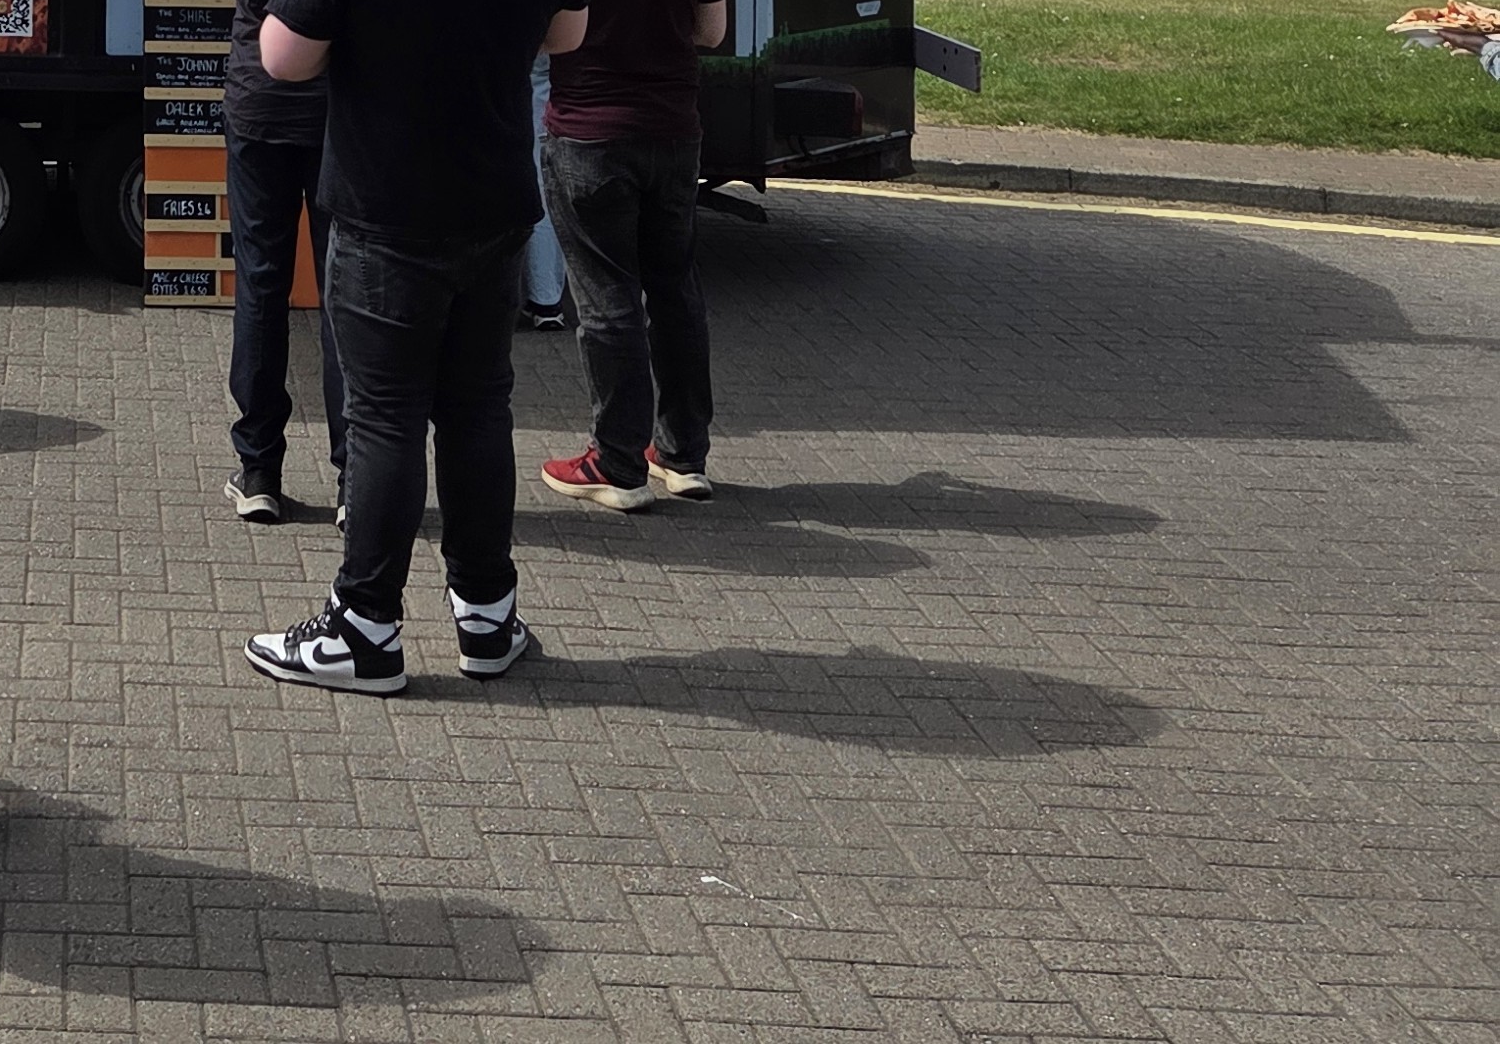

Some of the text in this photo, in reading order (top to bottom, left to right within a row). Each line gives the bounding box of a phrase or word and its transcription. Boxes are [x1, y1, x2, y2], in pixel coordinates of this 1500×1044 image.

[179, 9, 212, 24] SHIRE
[165, 101, 204, 116] DALEK
[163, 199, 195, 216] FRIES
[152, 272, 171, 283] MAC
[179, 272, 211, 284] CHEESE
[152, 283, 179, 296] BYTES
